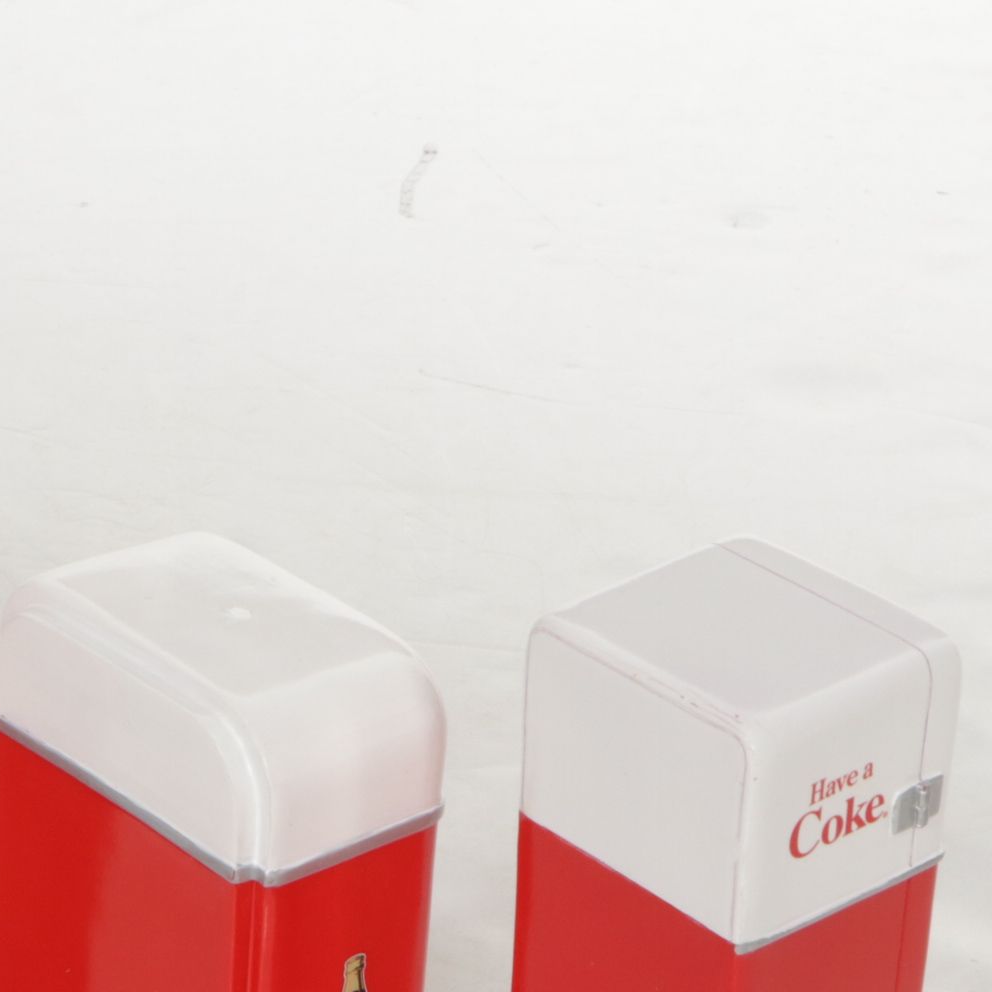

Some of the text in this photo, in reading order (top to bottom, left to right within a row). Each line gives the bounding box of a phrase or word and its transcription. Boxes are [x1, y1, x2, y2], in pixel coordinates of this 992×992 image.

[809, 762, 874, 806] Have a
[789, 793, 885, 859] Coke
